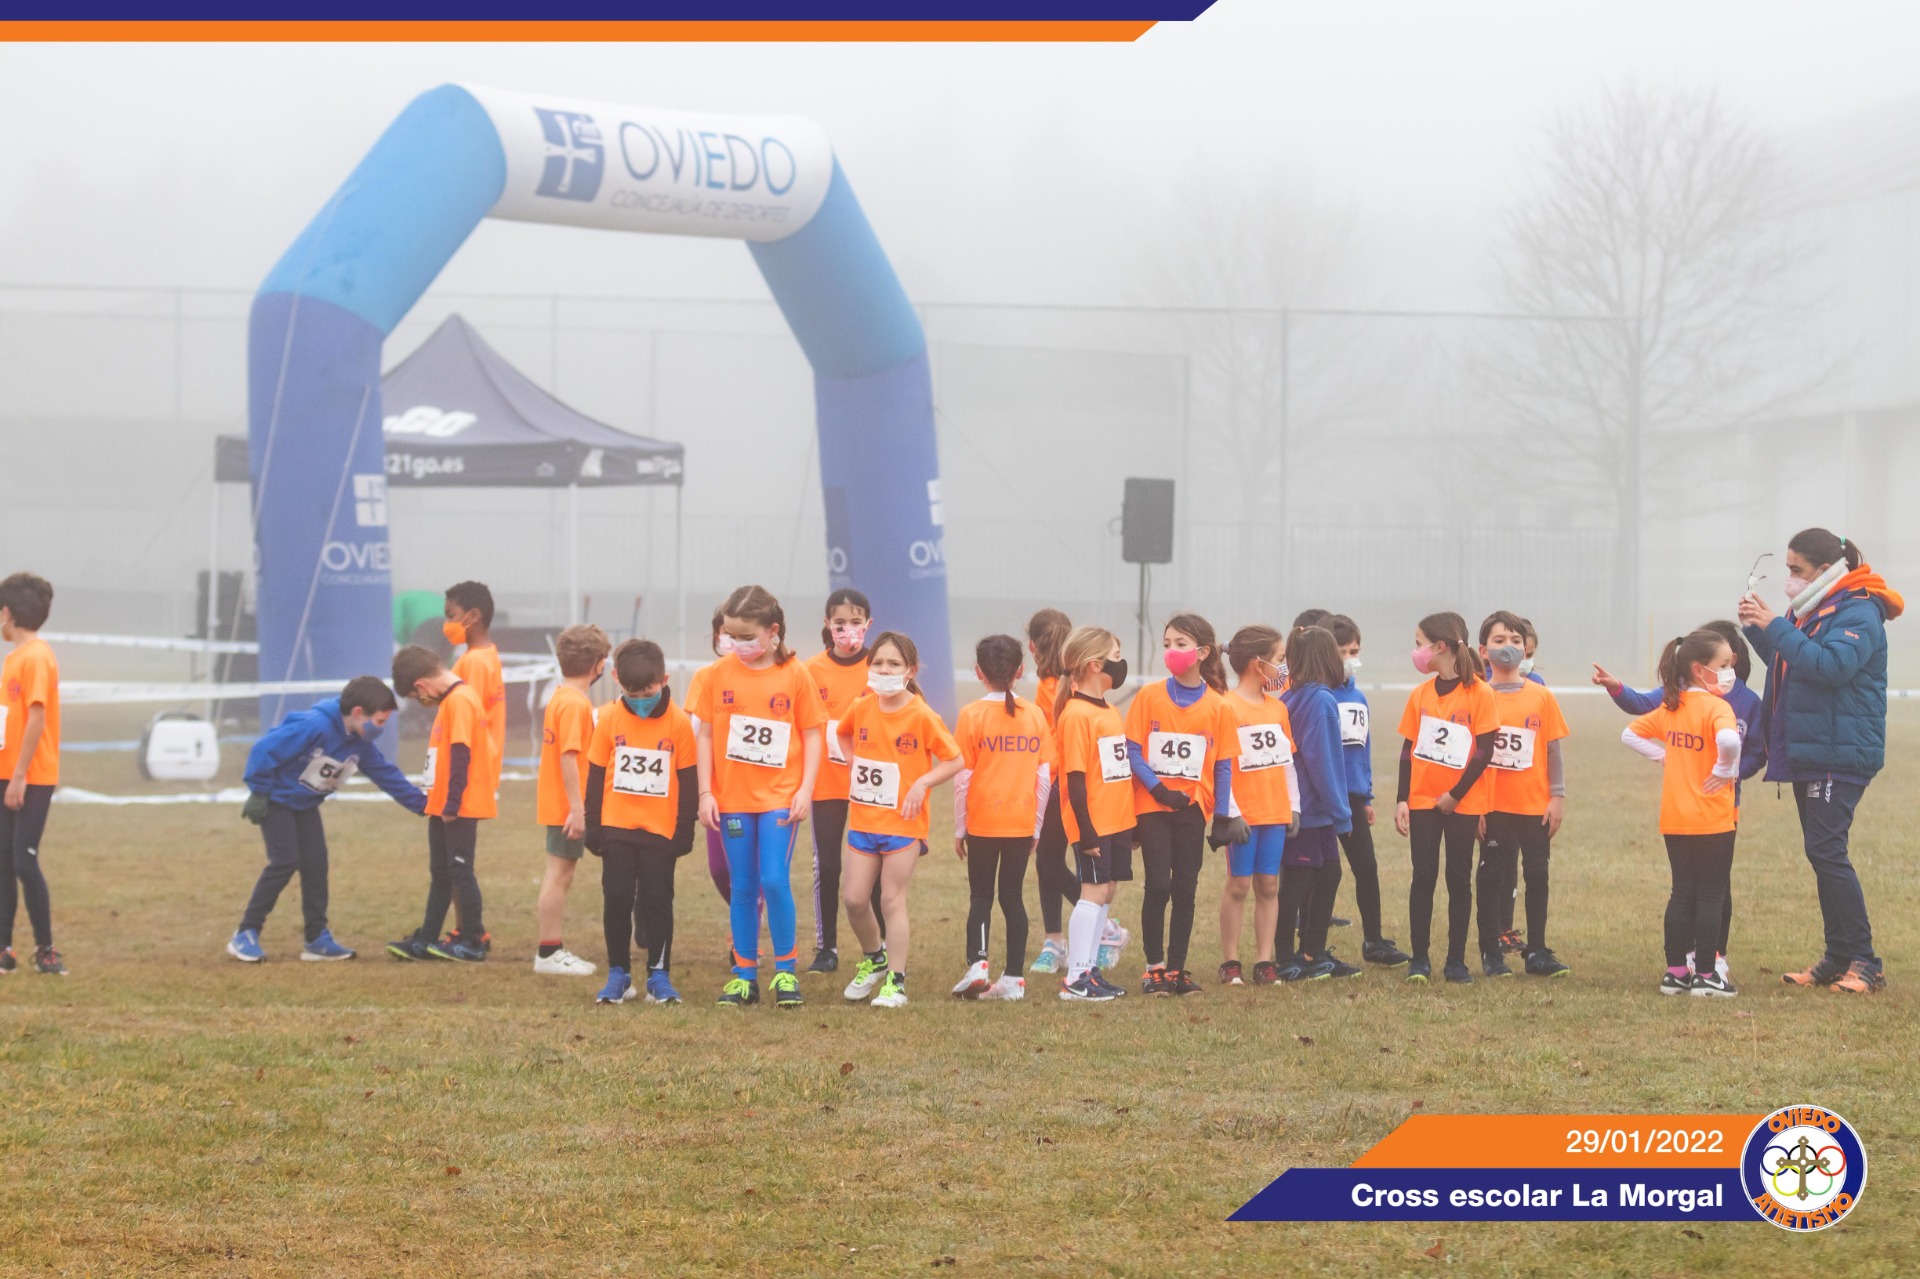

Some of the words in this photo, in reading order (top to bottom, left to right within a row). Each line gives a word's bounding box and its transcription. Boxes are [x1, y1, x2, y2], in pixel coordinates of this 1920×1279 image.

[618, 120, 797, 196] OVIEDO
[1348, 708, 1365, 728] 78
[742, 724, 773, 746] 28
[1250, 731, 1277, 750] 38
[1434, 726, 1449, 746] 2
[1494, 732, 1522, 752] 55
[1160, 739, 1192, 759] 46
[620, 754, 664, 777] 234
[856, 765, 883, 787] 36
